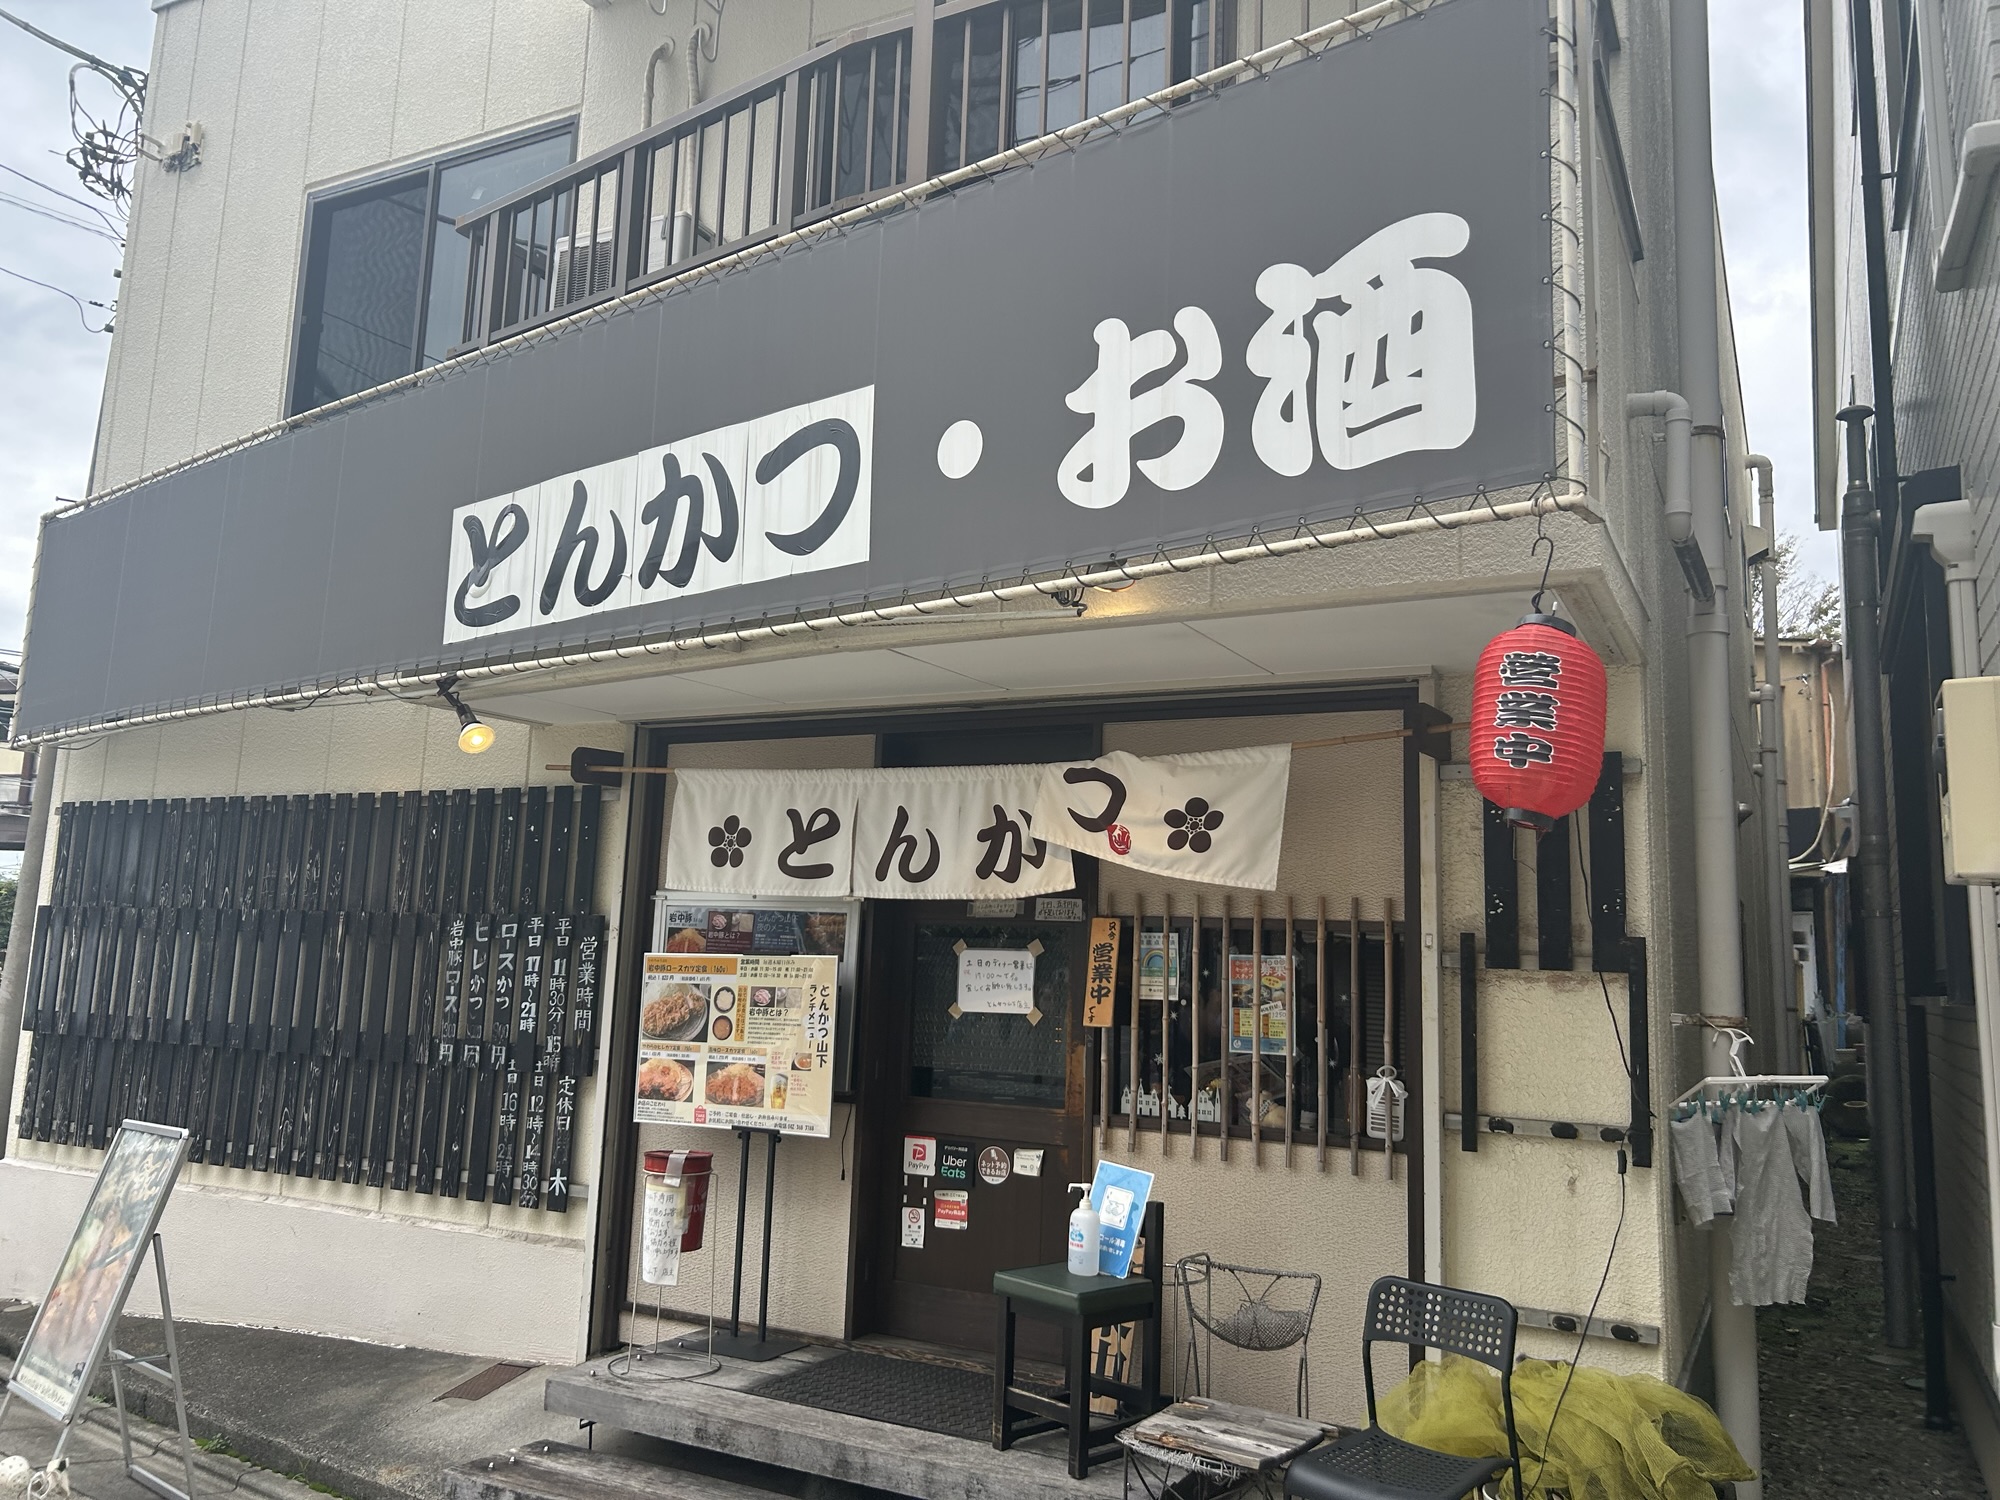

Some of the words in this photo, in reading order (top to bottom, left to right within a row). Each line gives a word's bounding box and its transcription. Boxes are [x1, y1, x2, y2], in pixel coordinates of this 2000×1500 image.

[454, 418, 861, 629] とんかつ
[1057, 212, 1478, 511] お酒
[1493, 651, 1562, 769] 営業中
[778, 767, 1127, 884] とんかつ
[574, 935, 599, 1032] 営業時間
[807, 984, 818, 1049] ランチメニュー
[816, 984, 831, 1069] とんかつ山下
[908, 1160, 931, 1171] PayPay
[940, 1165, 966, 1179] Eats
[942, 1154, 967, 1168] Uber
[981, 1160, 1008, 1169] ネット予約
